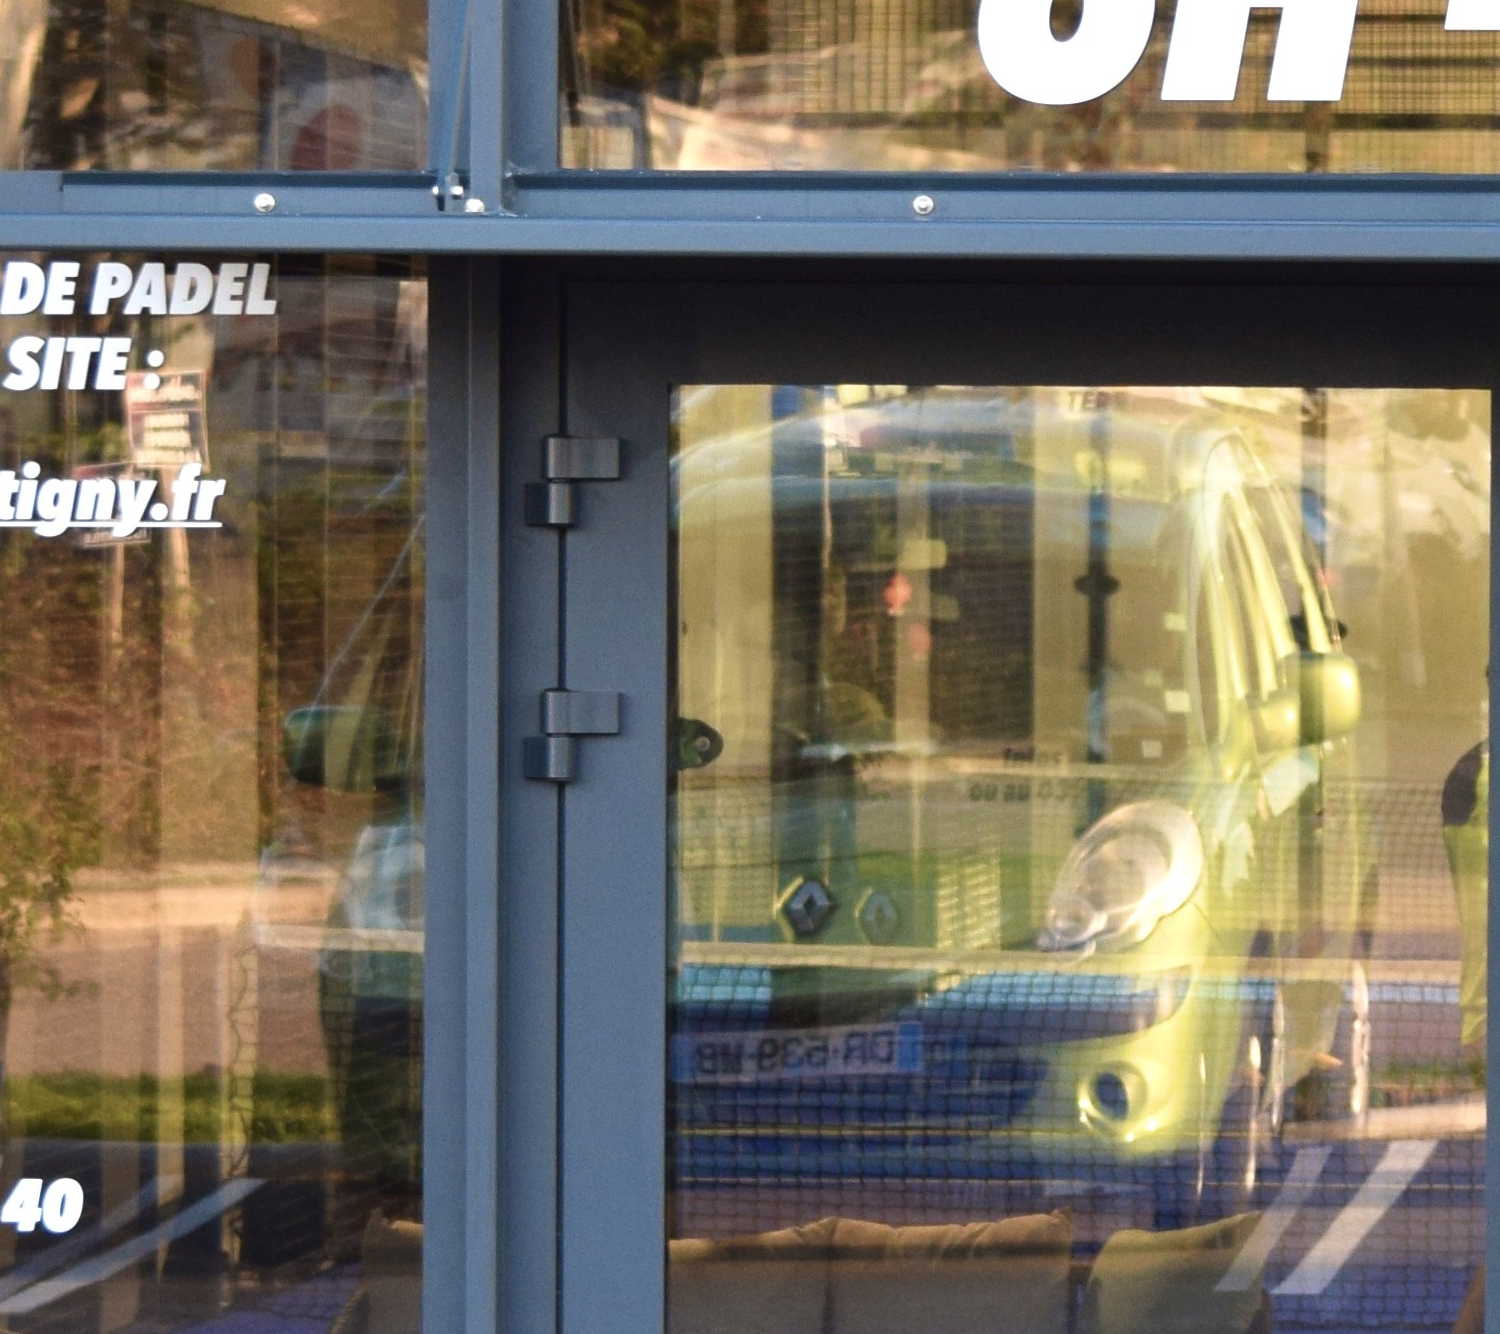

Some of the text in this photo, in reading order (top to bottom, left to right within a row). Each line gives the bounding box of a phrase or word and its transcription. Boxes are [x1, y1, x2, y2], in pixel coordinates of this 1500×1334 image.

[0, 262, 81, 315] DE
[91, 263, 278, 315] PADEL
[3, 336, 131, 391] SITE
[0, 1177, 84, 1233] 40
